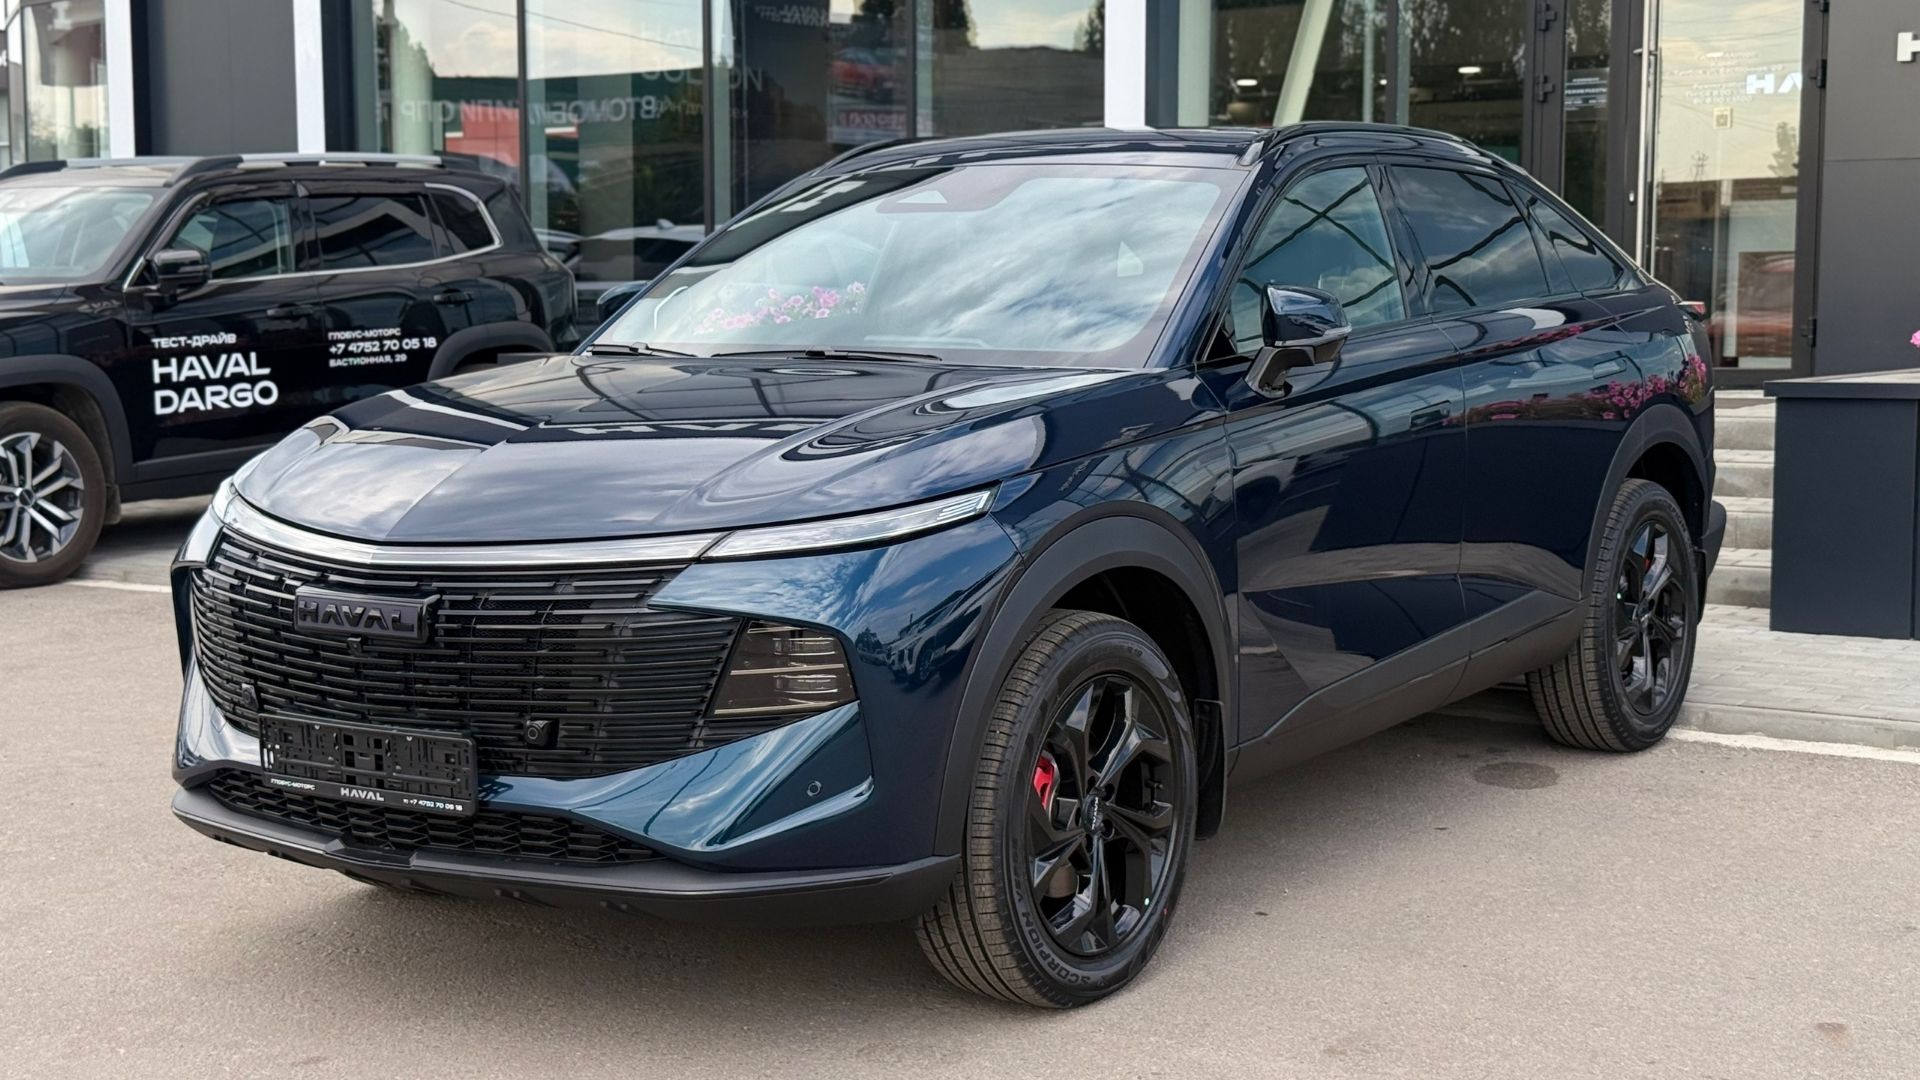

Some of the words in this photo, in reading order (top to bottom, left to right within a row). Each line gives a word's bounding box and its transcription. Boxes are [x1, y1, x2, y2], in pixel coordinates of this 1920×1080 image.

[151, 331, 237, 349] ТЕСТ-ДРАЙВ
[328, 327, 402, 340] ГЛОБУС-МОТОРС
[329, 342, 346, 355] +7
[347, 340, 381, 354] 4752
[382, 339, 400, 351] 70
[402, 337, 420, 350] 05
[422, 336, 438, 348] 18
[394, 353, 408, 363] 29
[152, 351, 272, 384] HAVAL
[154, 380, 279, 415] DARGO
[298, 600, 415, 632] HAVAL
[340, 786, 385, 802] HAVAL
[435, 801, 445, 809] 70
[1021, 910, 1091, 985] SCORPION
